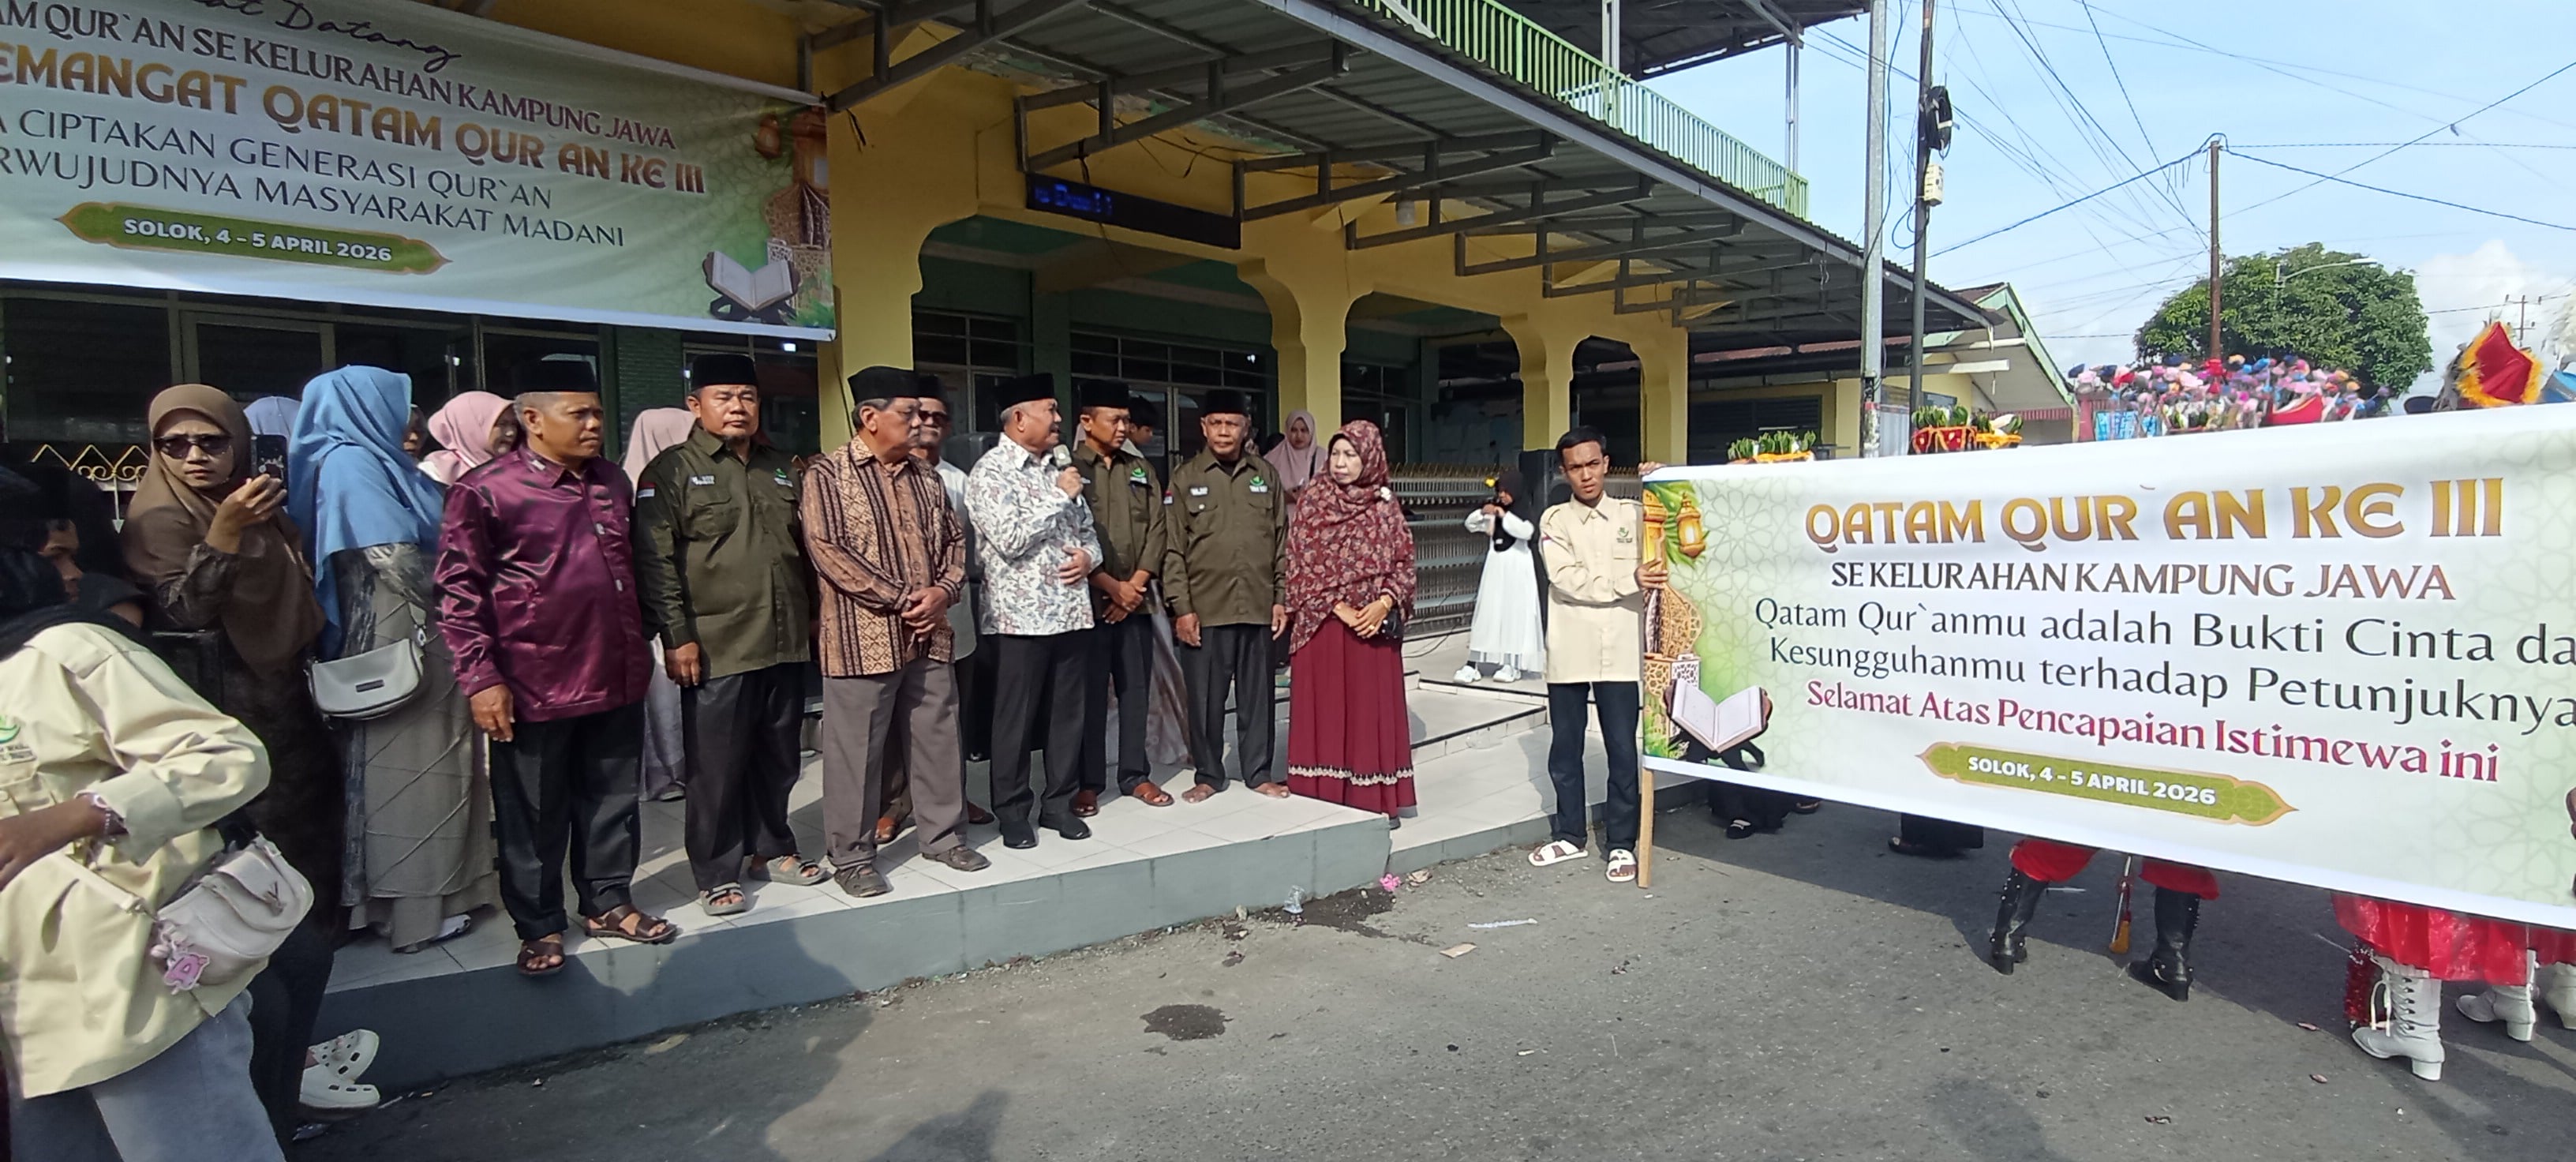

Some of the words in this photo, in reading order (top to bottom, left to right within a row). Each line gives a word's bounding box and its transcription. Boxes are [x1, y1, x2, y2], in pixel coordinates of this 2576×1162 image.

[193, 28, 236, 62] SE
[243, 37, 451, 106] KELURAHAN
[458, 84, 601, 135] KAMPUNG
[606, 118, 676, 150] JAWA
[19, 109, 215, 158] CIPTAKAN
[230, 137, 415, 189] GENERASI
[263, 84, 441, 151] QATAM
[620, 155, 667, 189] KE
[675, 163, 704, 194] III
[125, 219, 211, 244] SOLOK,
[217, 229, 230, 242] 4
[253, 234, 266, 248] 5
[271, 236, 332, 255] APRIL
[337, 242, 391, 262] 2026
[256, 177, 492, 232] MASYARAKAT
[504, 214, 624, 247] MADANI
[1806, 499, 1986, 553] QATAM
[2290, 482, 2405, 539] KE
[2429, 477, 2503, 538] III
[1832, 562, 1864, 587] SE
[1869, 562, 2067, 592] KELURAHAN
[2076, 562, 2293, 598] KAMPUNG
[2304, 564, 2456, 601] JAWA
[1755, 598, 1846, 629] Qatam
[2040, 608, 2172, 647] adalah
[2193, 612, 2323, 654] Bukti
[2346, 618, 2495, 662] Cinta
[2516, 623, 2576, 665] da
[1770, 636, 2025, 683] Kesungguhanmu
[2039, 656, 2228, 707] terhadap
[2248, 666, 2576, 736] Petunjuknya
[1807, 680, 1912, 718] Selamat
[1919, 692, 1990, 725] Atas
[1998, 699, 2204, 750] Pencapaian
[2215, 719, 2428, 774] Istimewa
[2439, 739, 2500, 783] ini
[1968, 755, 2035, 782] SOLOK,
[2040, 766, 2054, 782] 4
[2071, 770, 2083, 785] 5
[2087, 771, 2149, 797] APRIL
[2153, 784, 2216, 805] 2026
